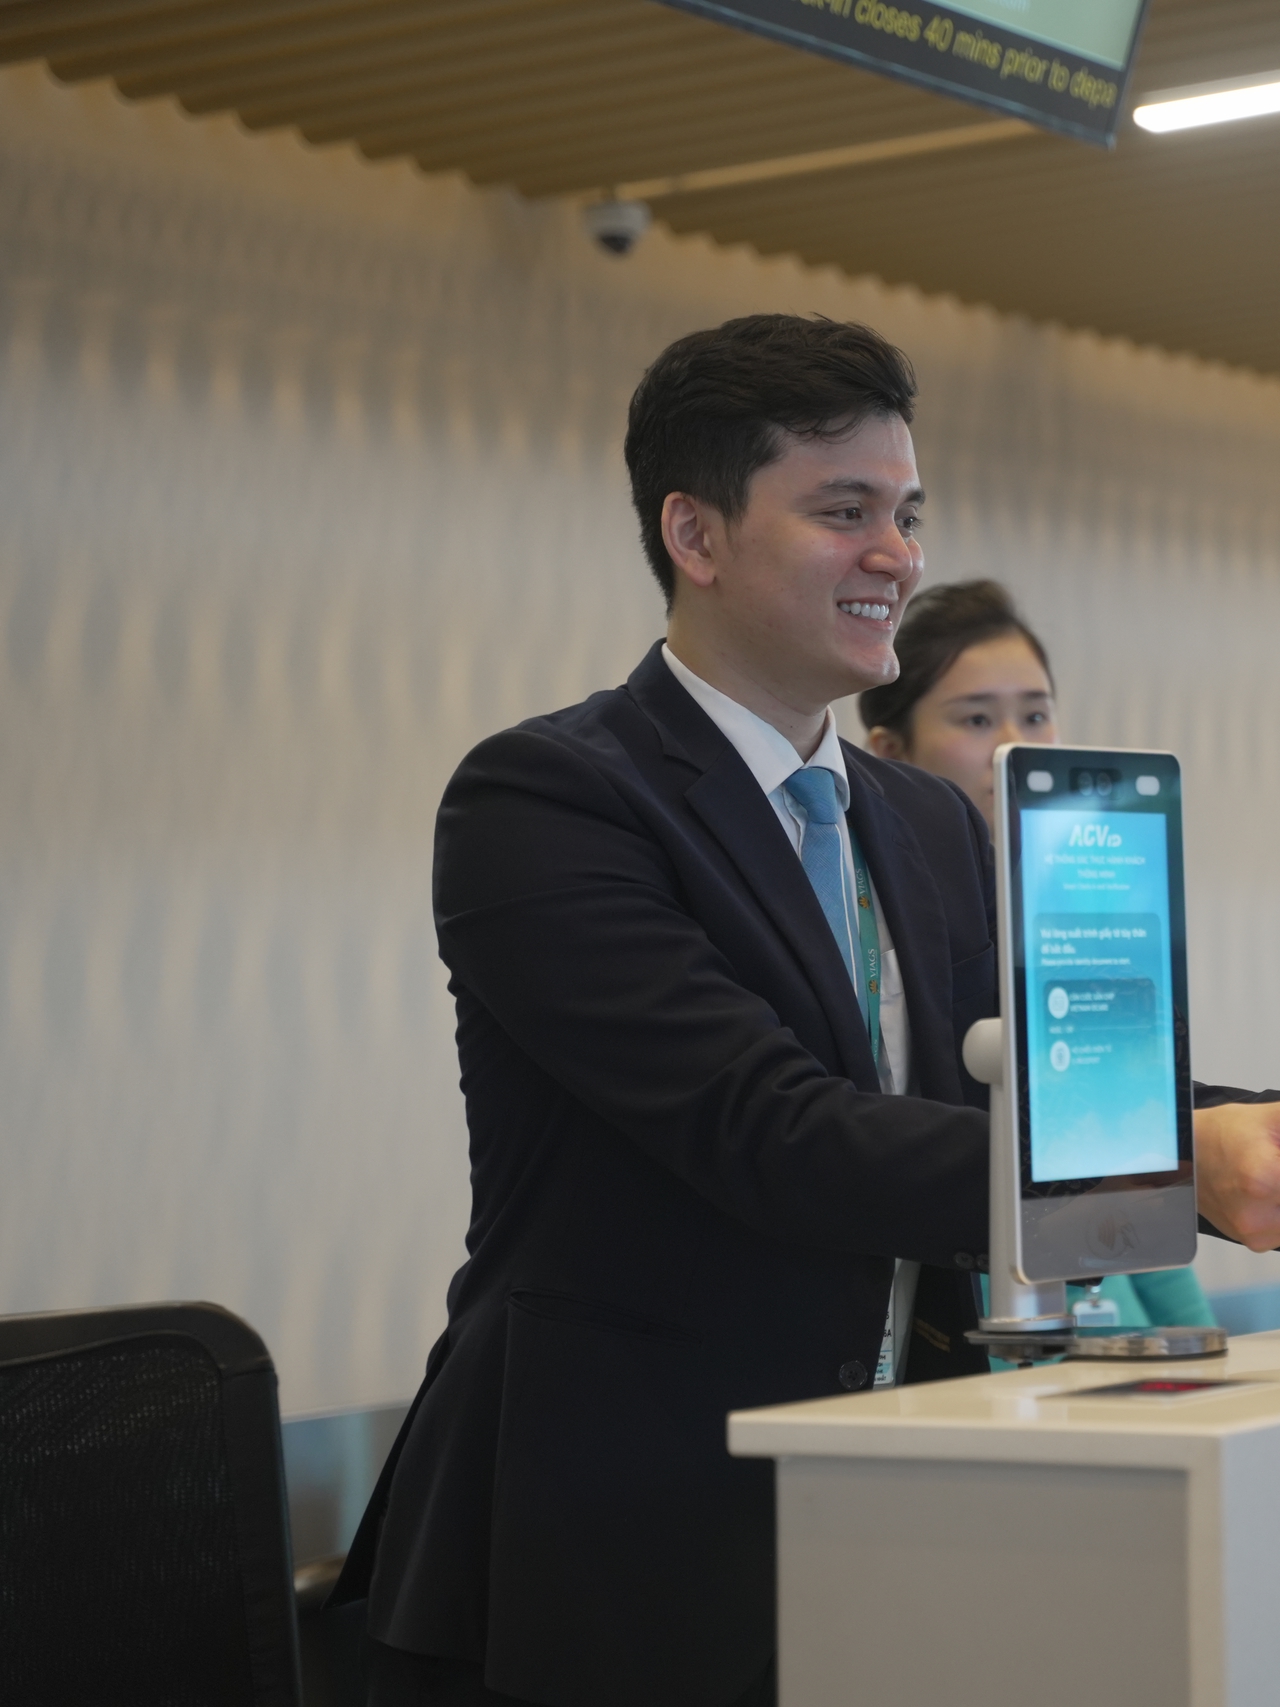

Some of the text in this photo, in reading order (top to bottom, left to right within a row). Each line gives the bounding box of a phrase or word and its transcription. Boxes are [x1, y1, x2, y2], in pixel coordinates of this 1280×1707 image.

[854, 0, 923, 42] closes
[923, 14, 954, 53] 40
[952, 29, 1003, 70] mins
[1000, 47, 1050, 86] prior
[1048, 57, 1071, 93] to
[868, 948, 877, 978] VIAGS
